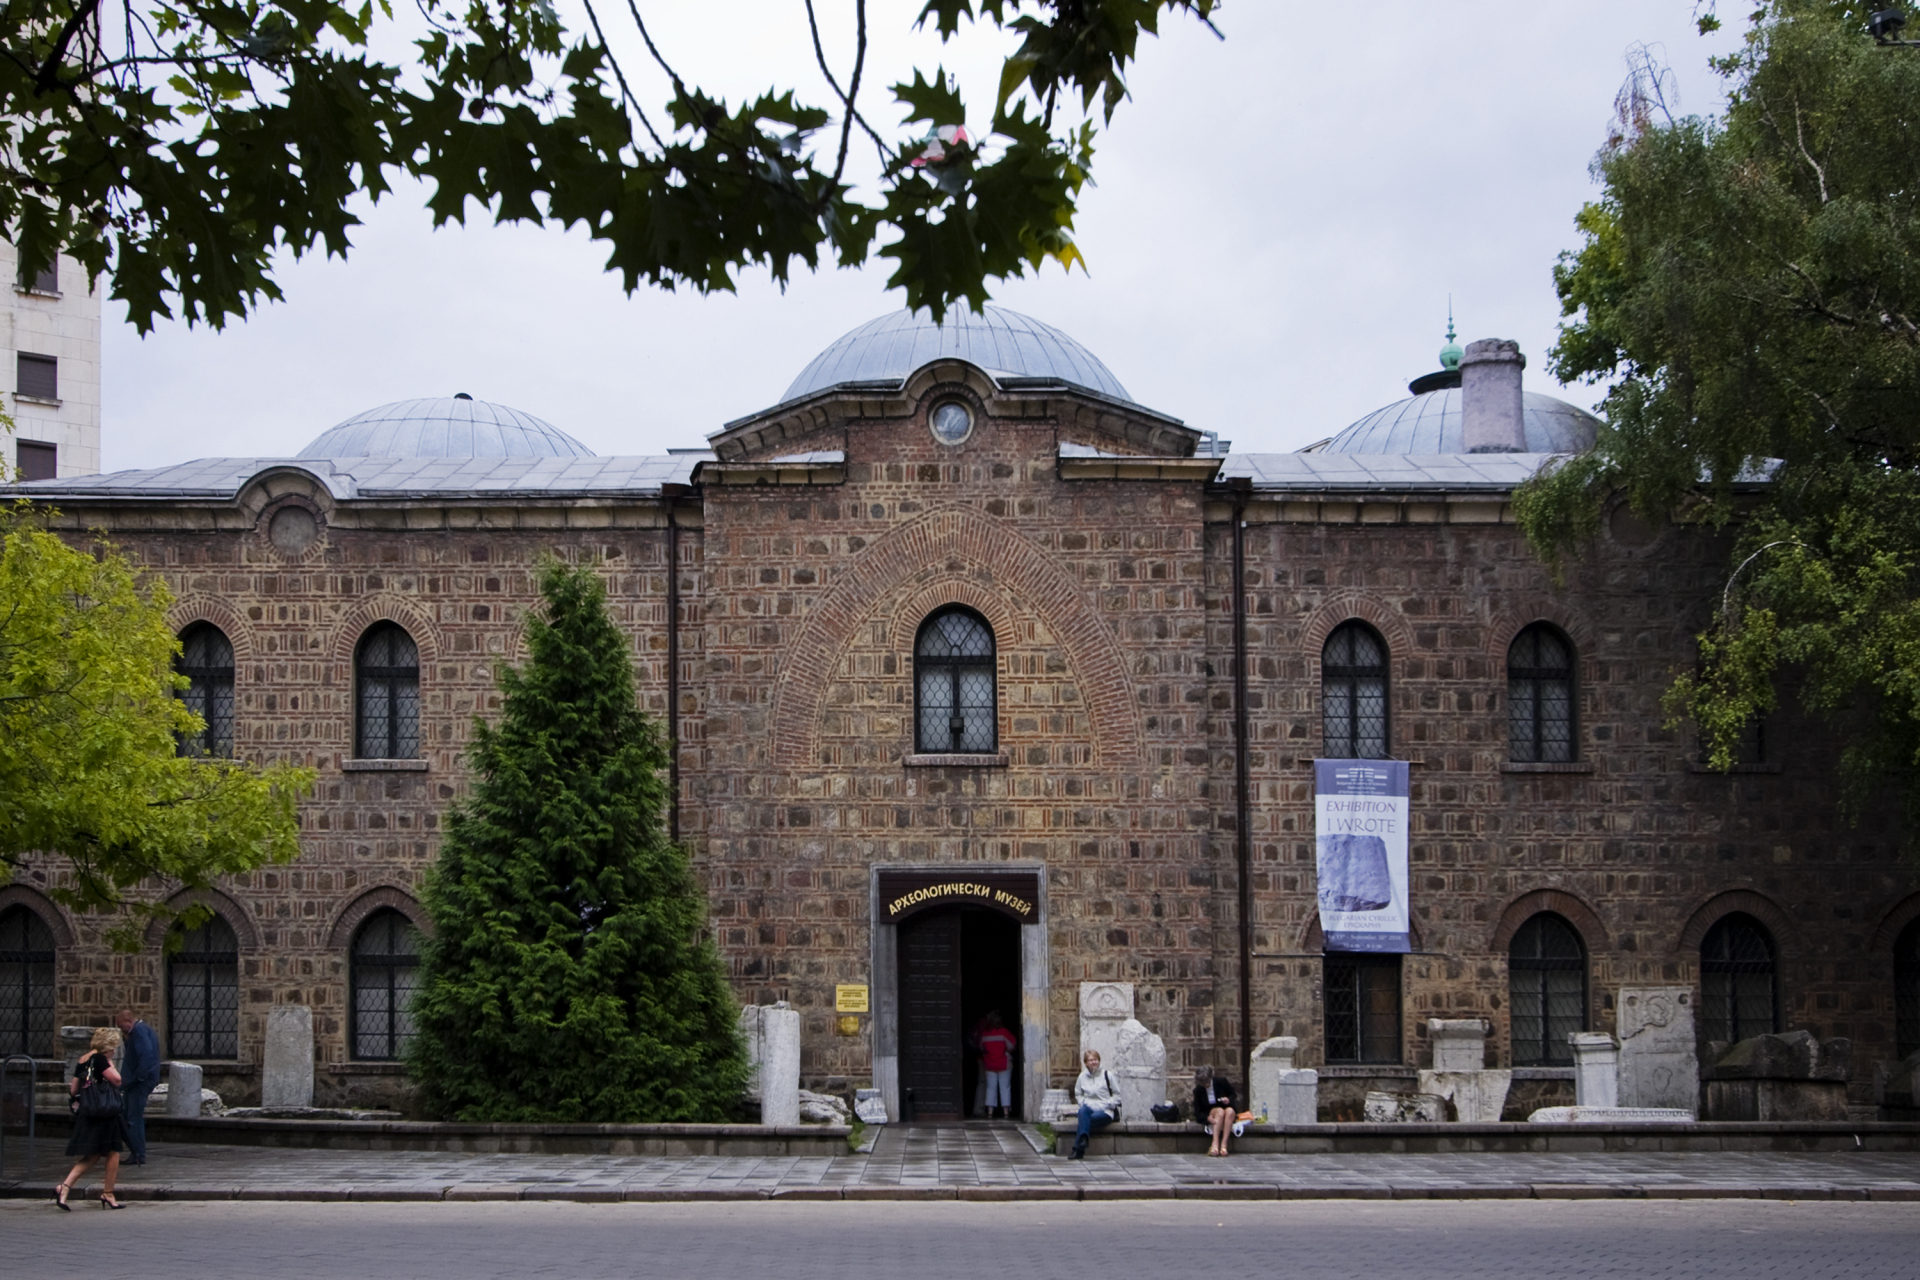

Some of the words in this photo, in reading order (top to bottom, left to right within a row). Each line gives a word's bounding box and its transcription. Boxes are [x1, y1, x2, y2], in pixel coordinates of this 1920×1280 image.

[1326, 801, 1397, 813] EXHIBITION
[1327, 818, 1331, 831] I
[1336, 818, 1396, 833] WROTE
[888, 883, 990, 916] АРХЕОЛОГИЧЕСКИ
[994, 889, 1032, 916] МУЗЕЙ
[1329, 914, 1367, 922] BULGARIAN
[1368, 914, 1398, 922] CYRILLIC
